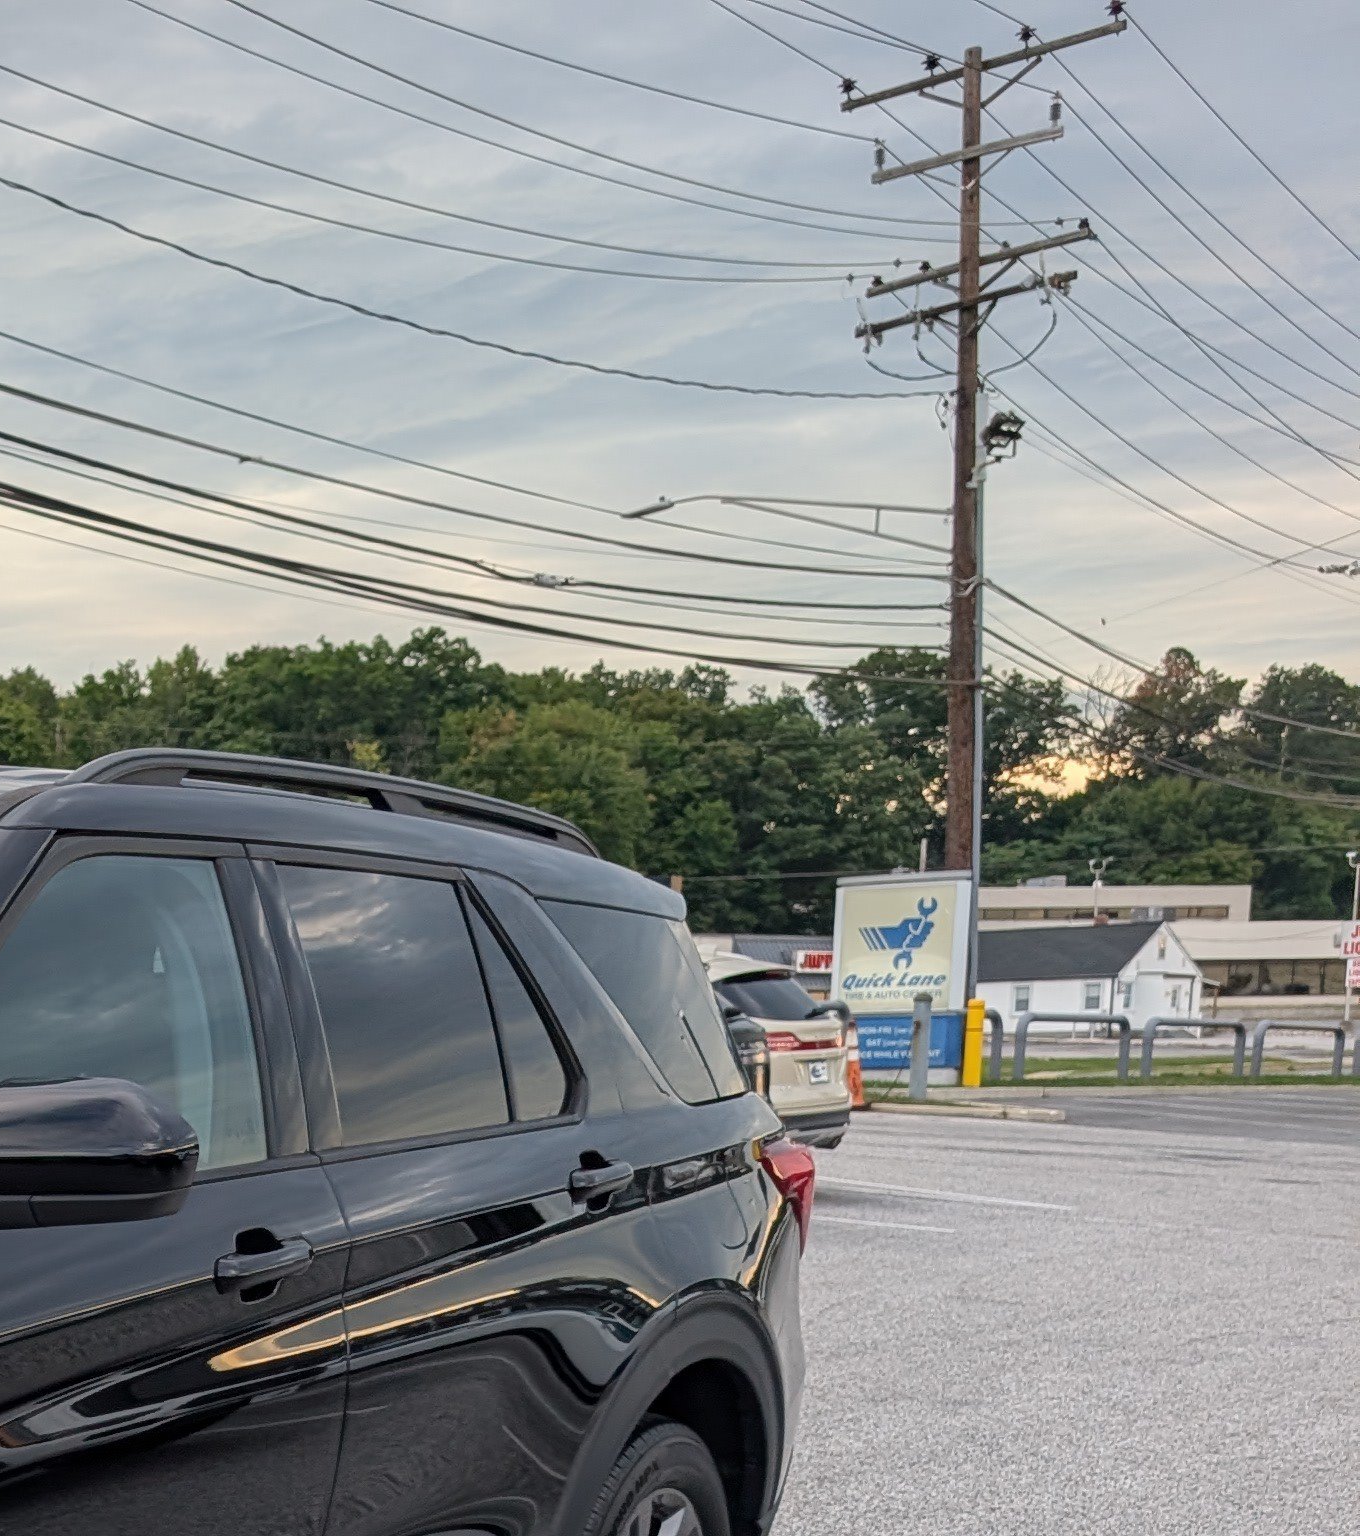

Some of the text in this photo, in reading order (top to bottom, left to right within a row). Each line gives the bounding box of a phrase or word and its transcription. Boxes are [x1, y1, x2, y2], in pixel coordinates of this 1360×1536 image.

[842, 972, 947, 990] Quick Lane
[874, 990, 900, 999] AUTO
